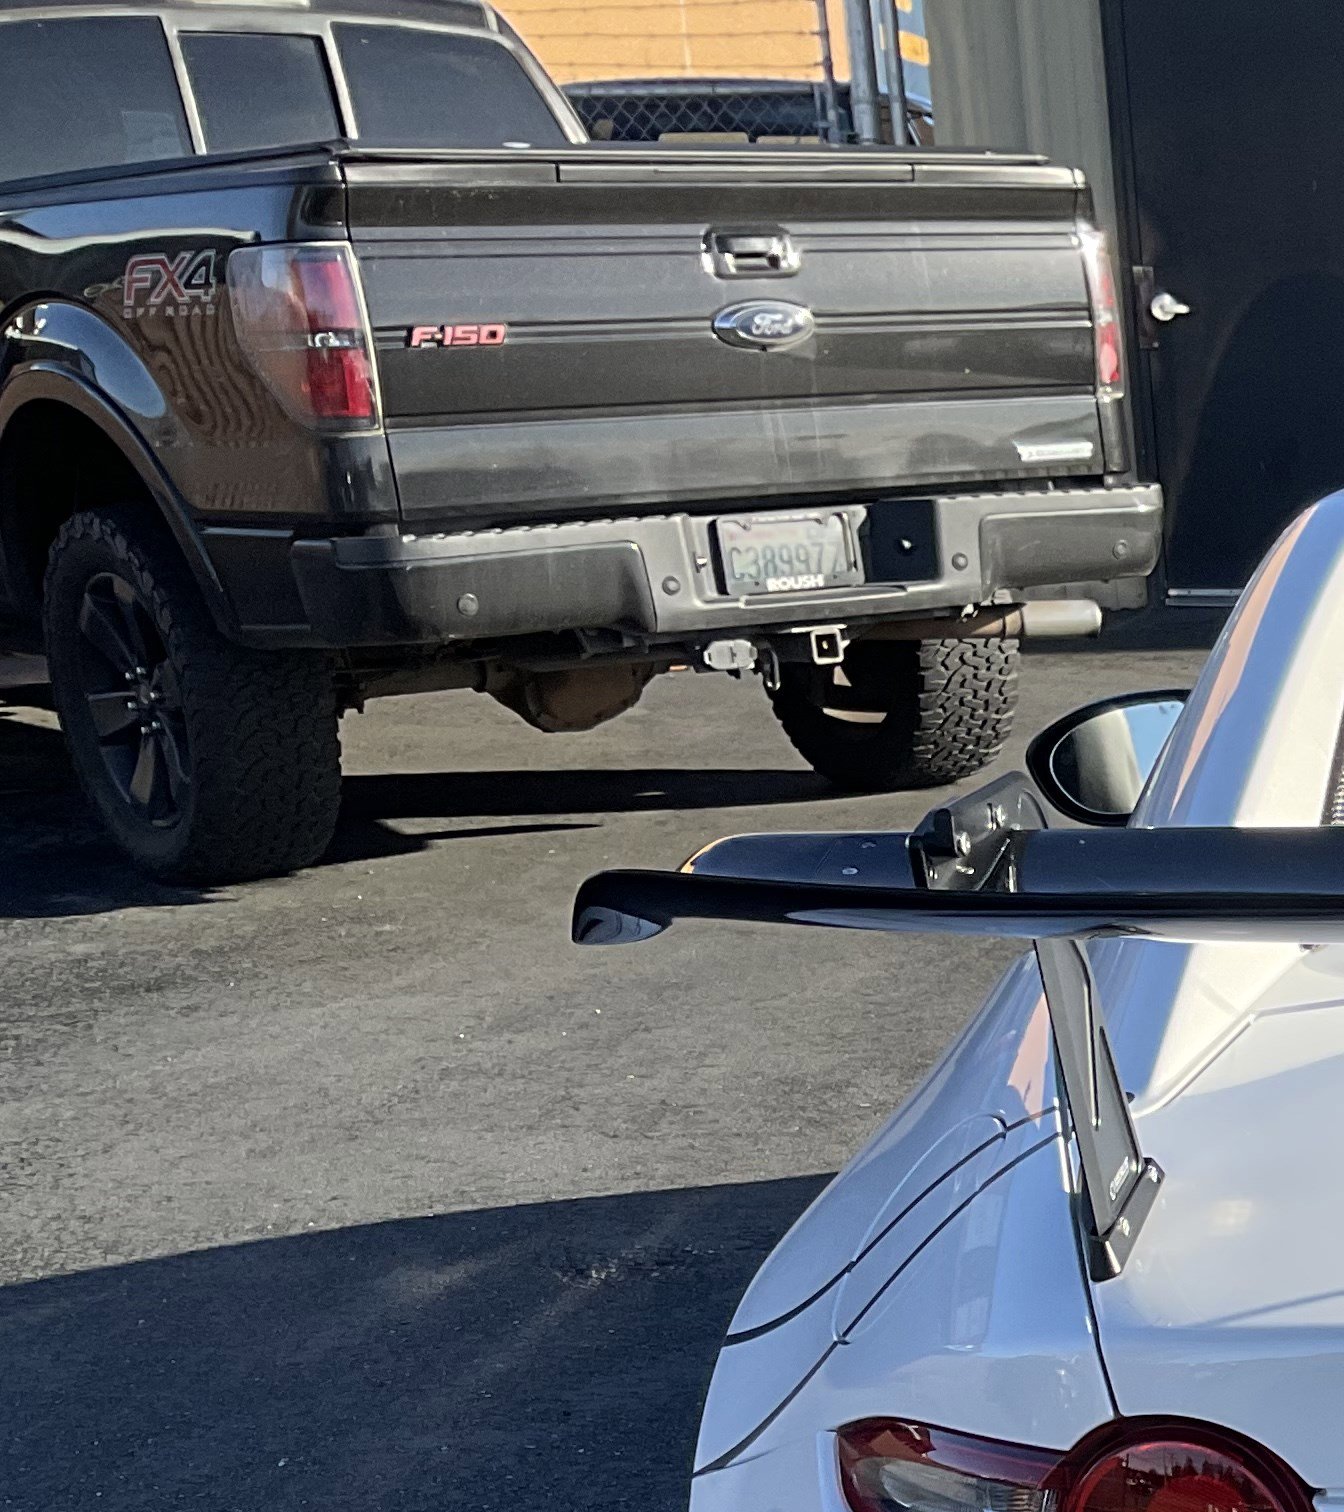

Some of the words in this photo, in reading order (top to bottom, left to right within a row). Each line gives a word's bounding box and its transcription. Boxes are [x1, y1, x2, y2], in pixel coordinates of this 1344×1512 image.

[123, 249, 217, 305] FX4
[411, 323, 506, 347] F-150
[751, 312, 793, 335] Ford
[766, 574, 825, 592] ROUSH
